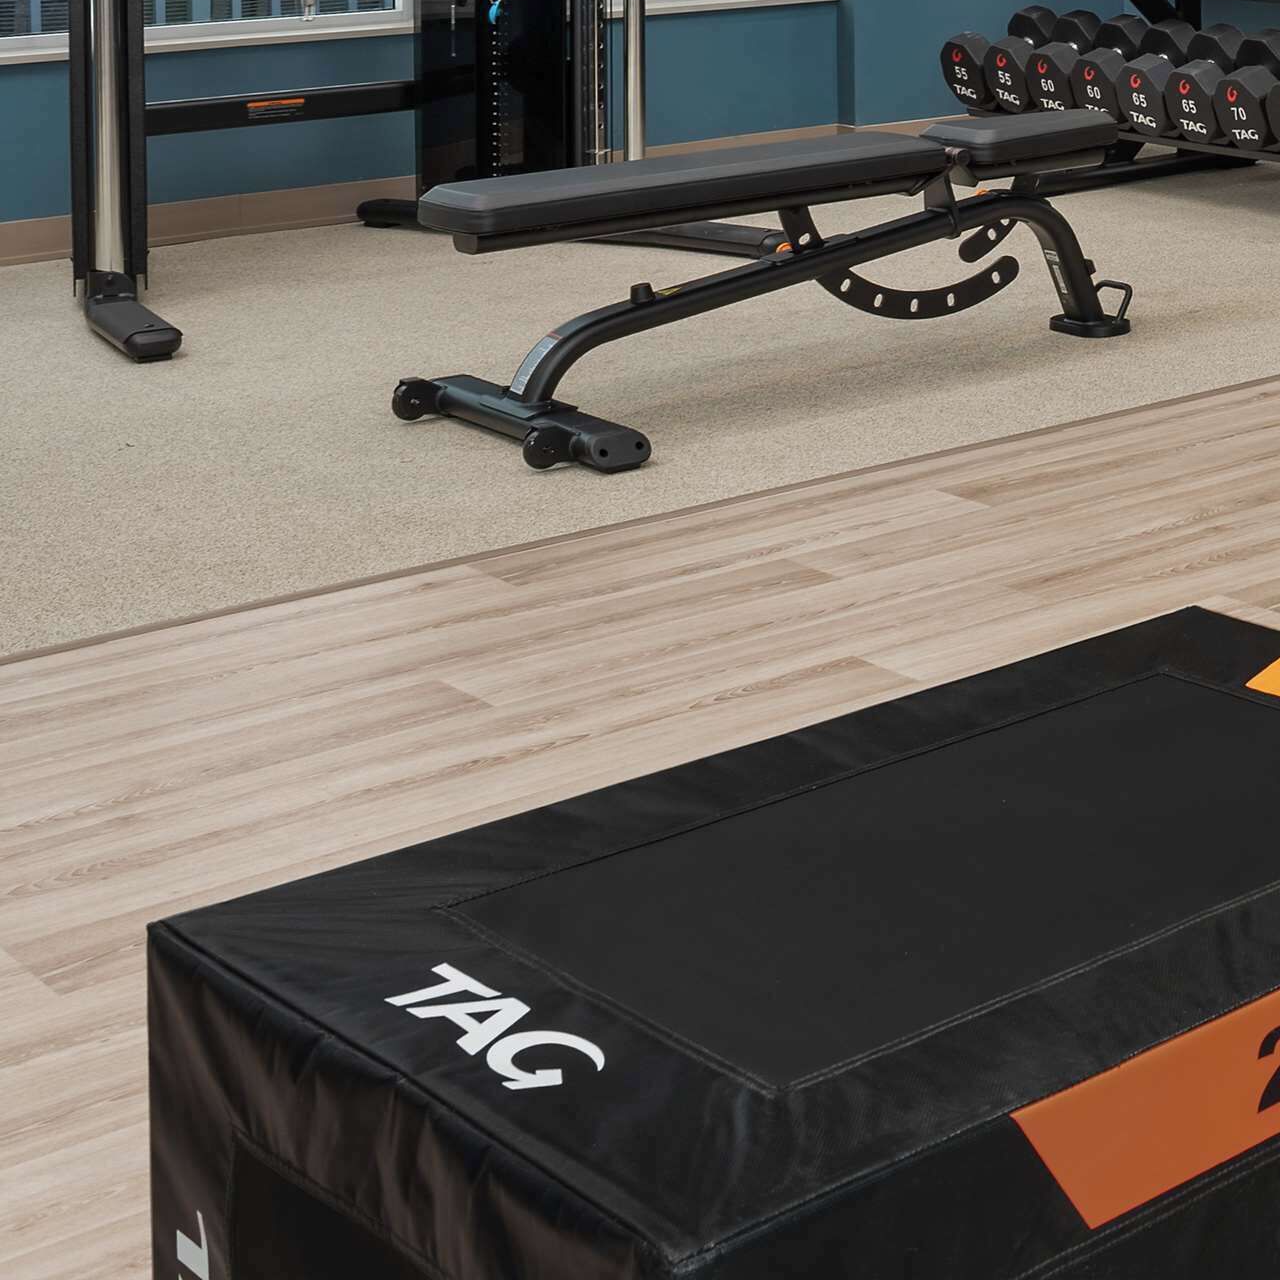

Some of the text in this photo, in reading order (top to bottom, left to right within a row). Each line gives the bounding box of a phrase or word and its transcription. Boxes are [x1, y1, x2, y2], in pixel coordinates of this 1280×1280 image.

[954, 66, 968, 80] 55
[998, 70, 1012, 86] 55
[953, 83, 977, 99] TAG
[1041, 78, 1055, 92] 60
[1087, 85, 1100, 99] 60
[995, 88, 1020, 105] TAG
[1132, 92, 1147, 108] 65
[1040, 98, 1065, 111] TAG
[1181, 99, 1197, 114] 65
[1129, 111, 1157, 128] TAG
[1230, 107, 1247, 121] 70
[1179, 118, 1207, 134] TAG
[1231, 129, 1259, 140] TAG
[384, 962, 605, 1090] TAG
